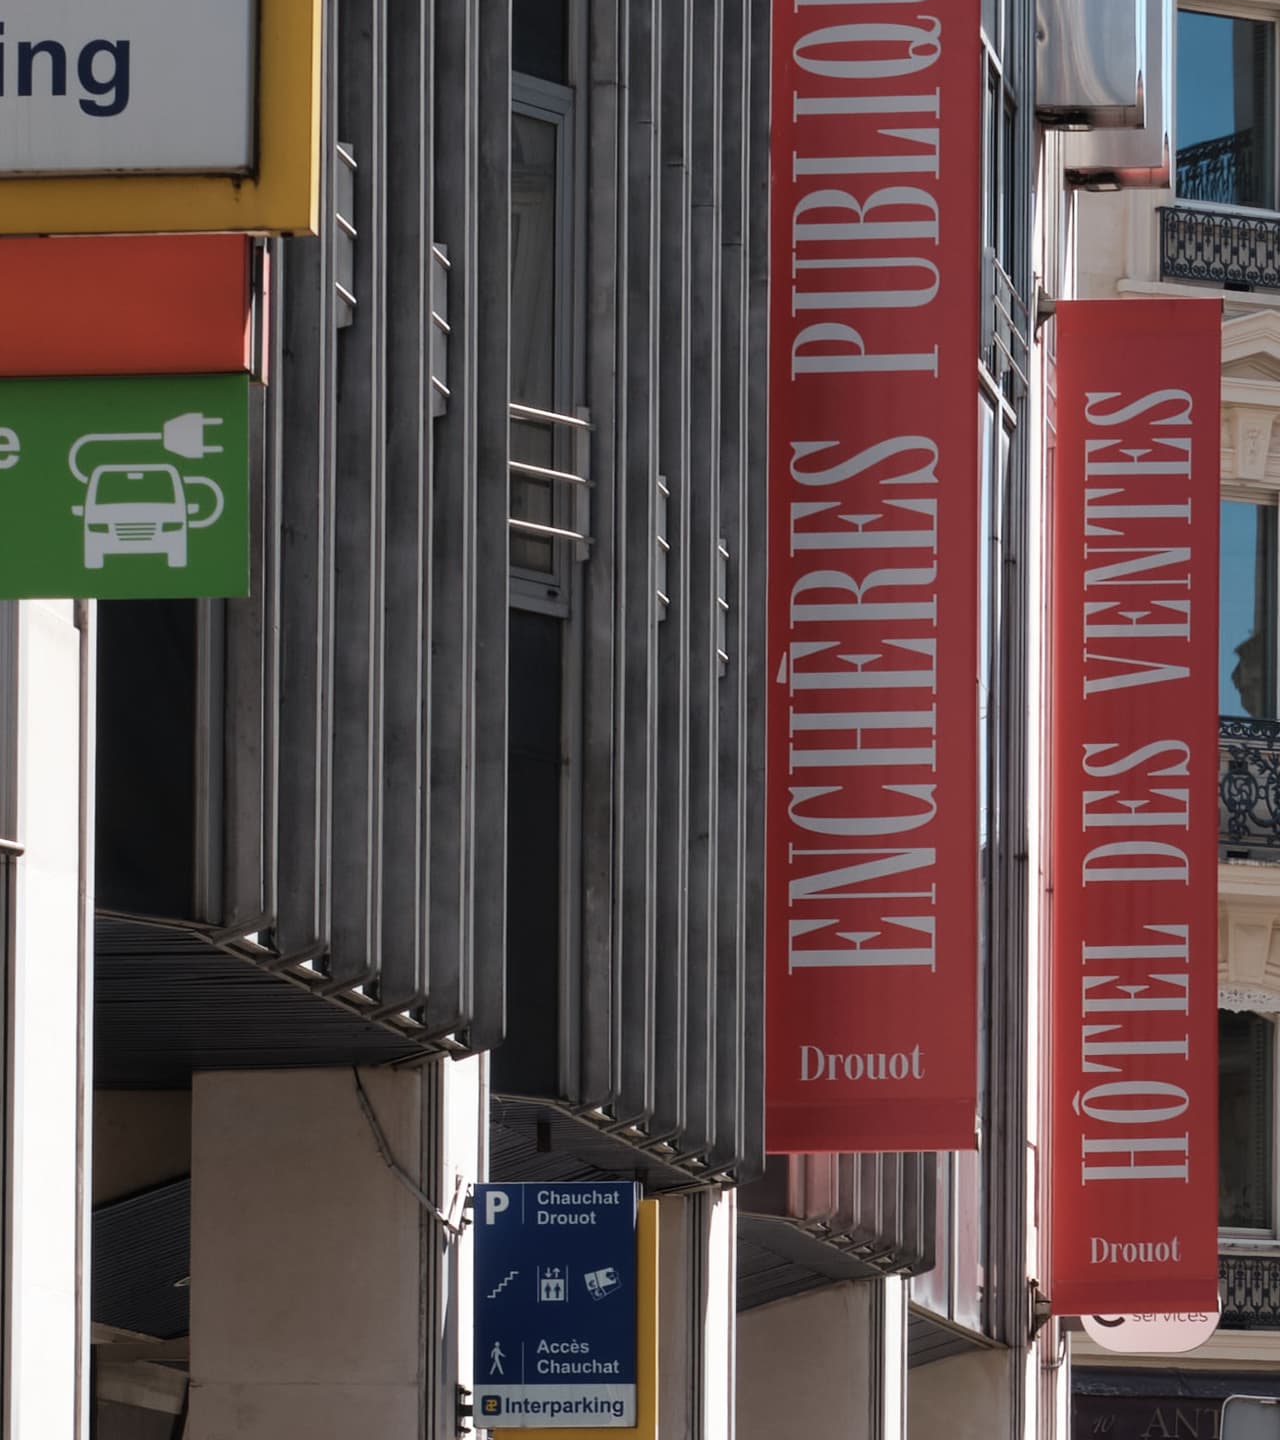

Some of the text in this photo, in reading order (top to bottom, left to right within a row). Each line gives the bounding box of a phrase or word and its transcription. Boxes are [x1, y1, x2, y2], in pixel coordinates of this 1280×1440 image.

[776, 434, 939, 976] ENCHÈRES
[1071, 387, 1194, 1187] HÔTEL DES VENTES
[799, 1044, 925, 1081] Drouot
[485, 1190, 619, 1225] P Chauchat
[536, 1210, 596, 1225] Drouot
[1090, 1237, 1181, 1264] Drouot
[536, 1339, 590, 1354] Accès
[536, 1359, 620, 1374] Chauchat
[505, 1396, 624, 1418] Interparking
[1140, 1407, 1220, 1440] ANT
